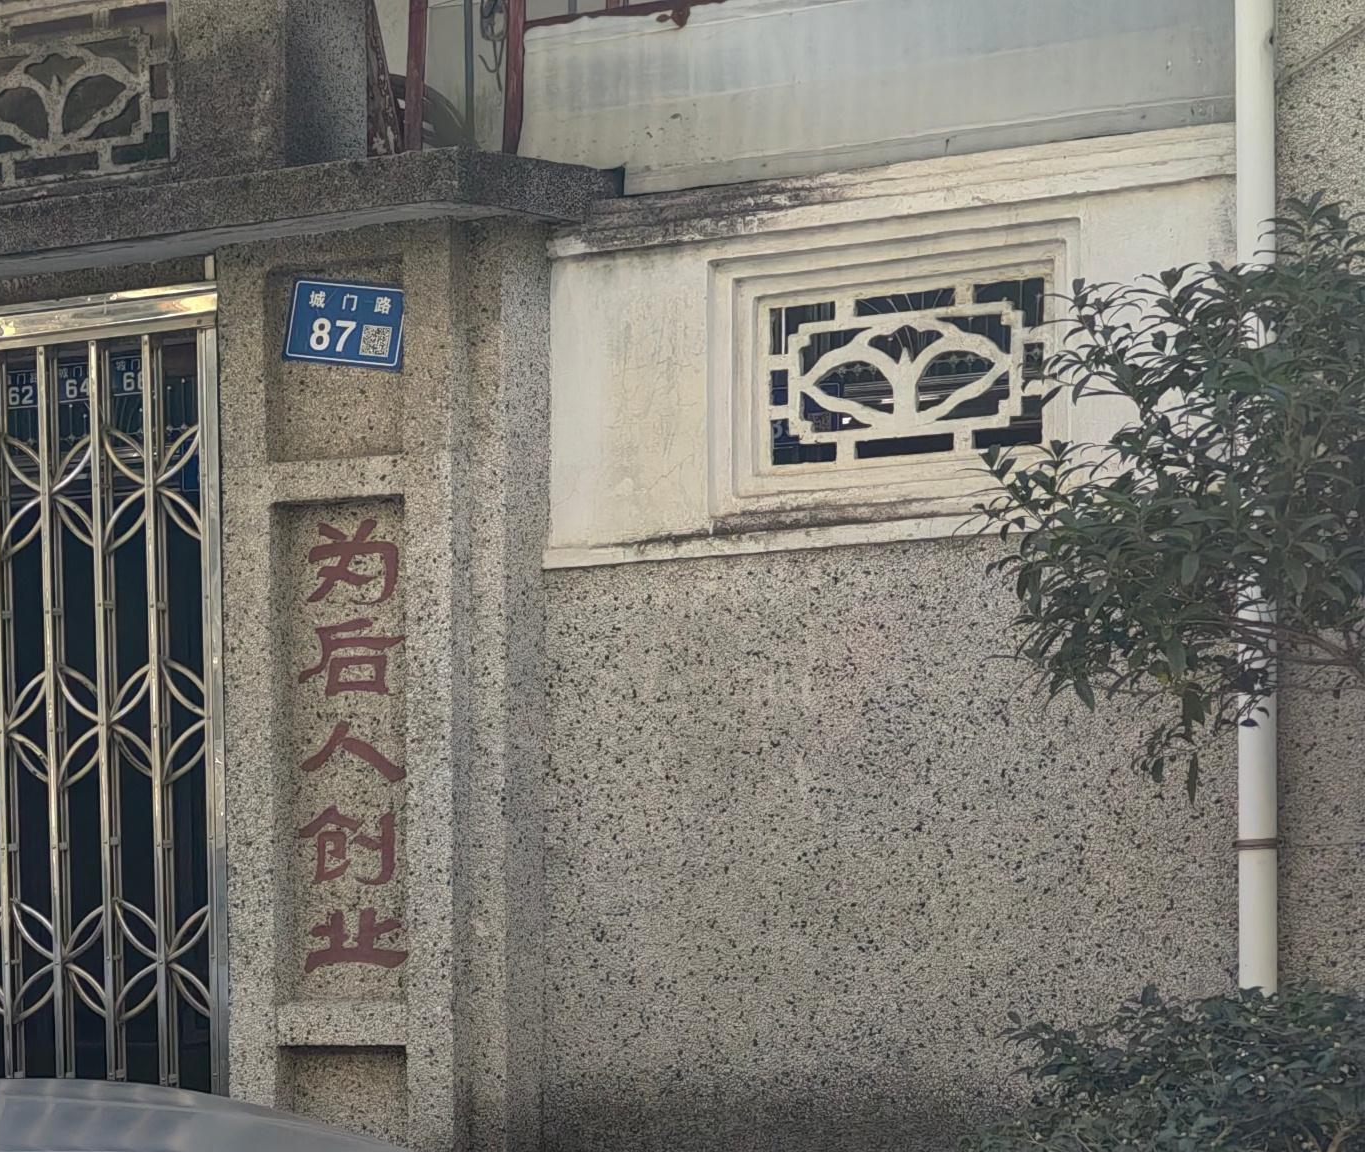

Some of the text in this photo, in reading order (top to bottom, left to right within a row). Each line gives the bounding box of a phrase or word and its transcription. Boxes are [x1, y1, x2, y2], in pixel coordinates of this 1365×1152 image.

[309, 290, 392, 315] 城门路
[309, 317, 357, 352] 87
[8, 385, 34, 406] 62
[65, 378, 89, 399] 64
[298, 519, 408, 973] 为后人创业
